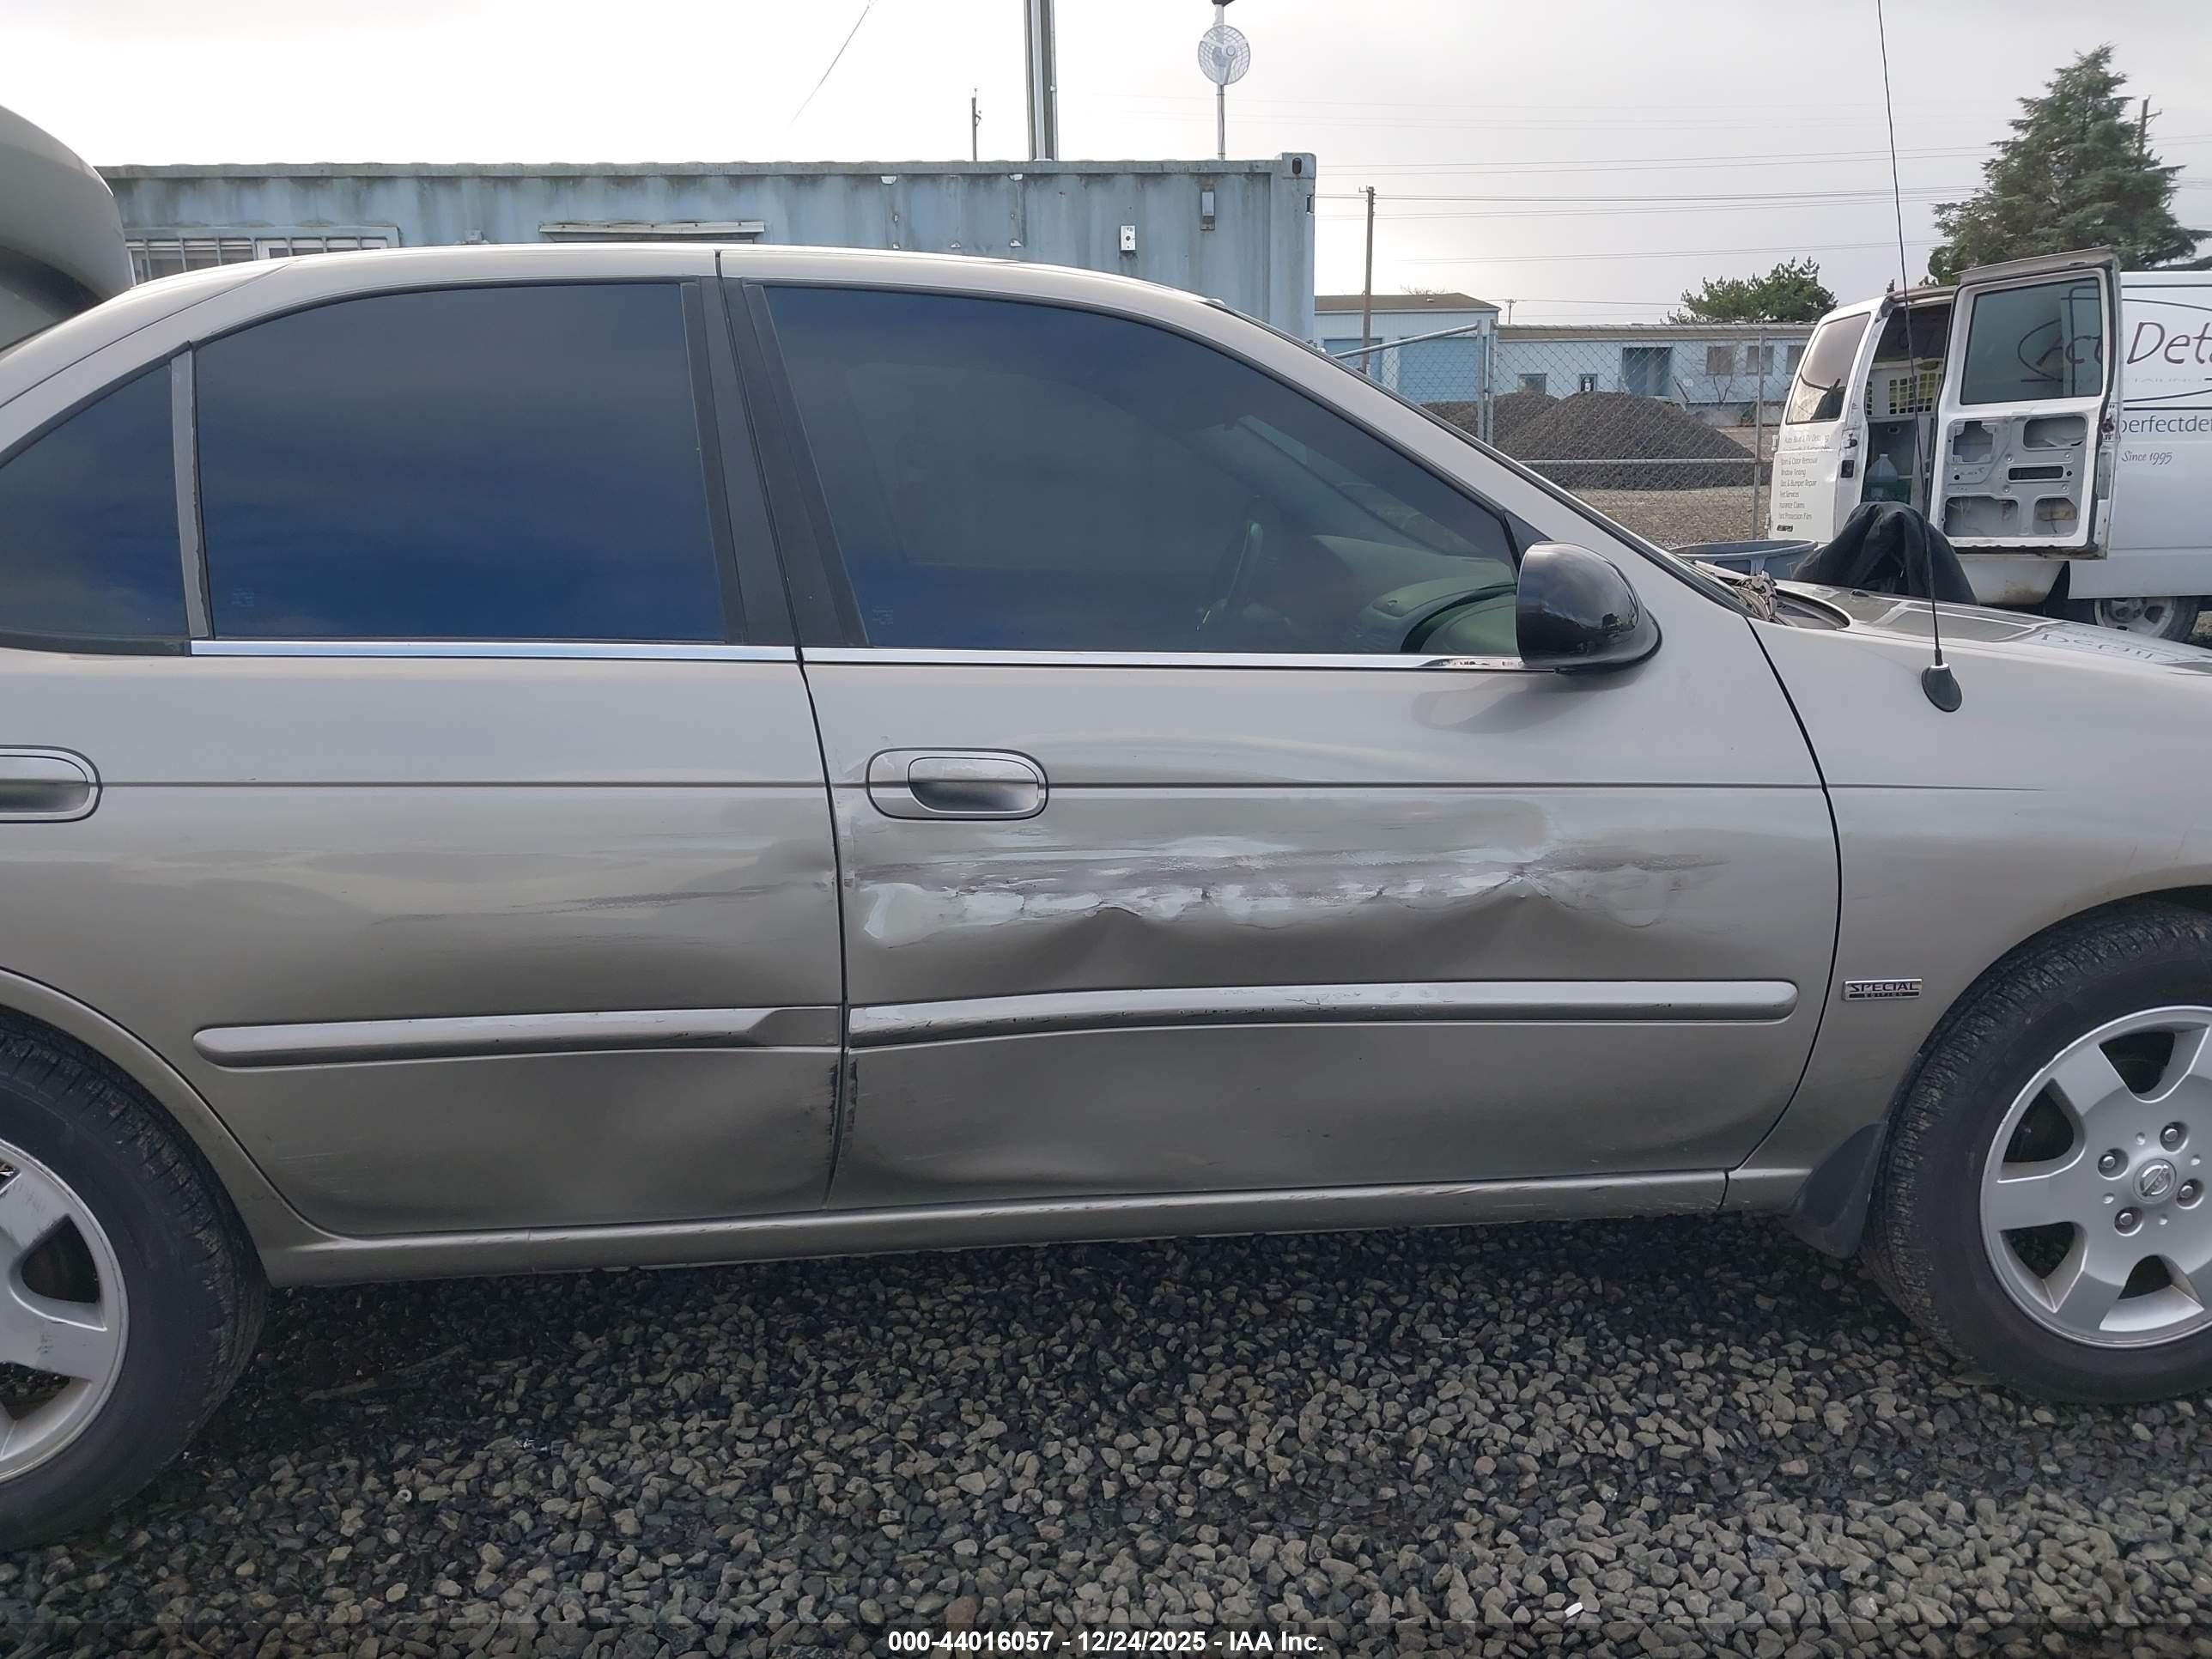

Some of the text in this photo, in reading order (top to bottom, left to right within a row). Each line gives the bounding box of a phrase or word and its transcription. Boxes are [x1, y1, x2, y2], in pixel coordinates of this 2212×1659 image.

[2127, 321, 2212, 365] Det
[2121, 415, 2212, 434] erfectde
[2122, 450, 2173, 465] Since 1995
[1849, 981, 1920, 994] SPECIAL
